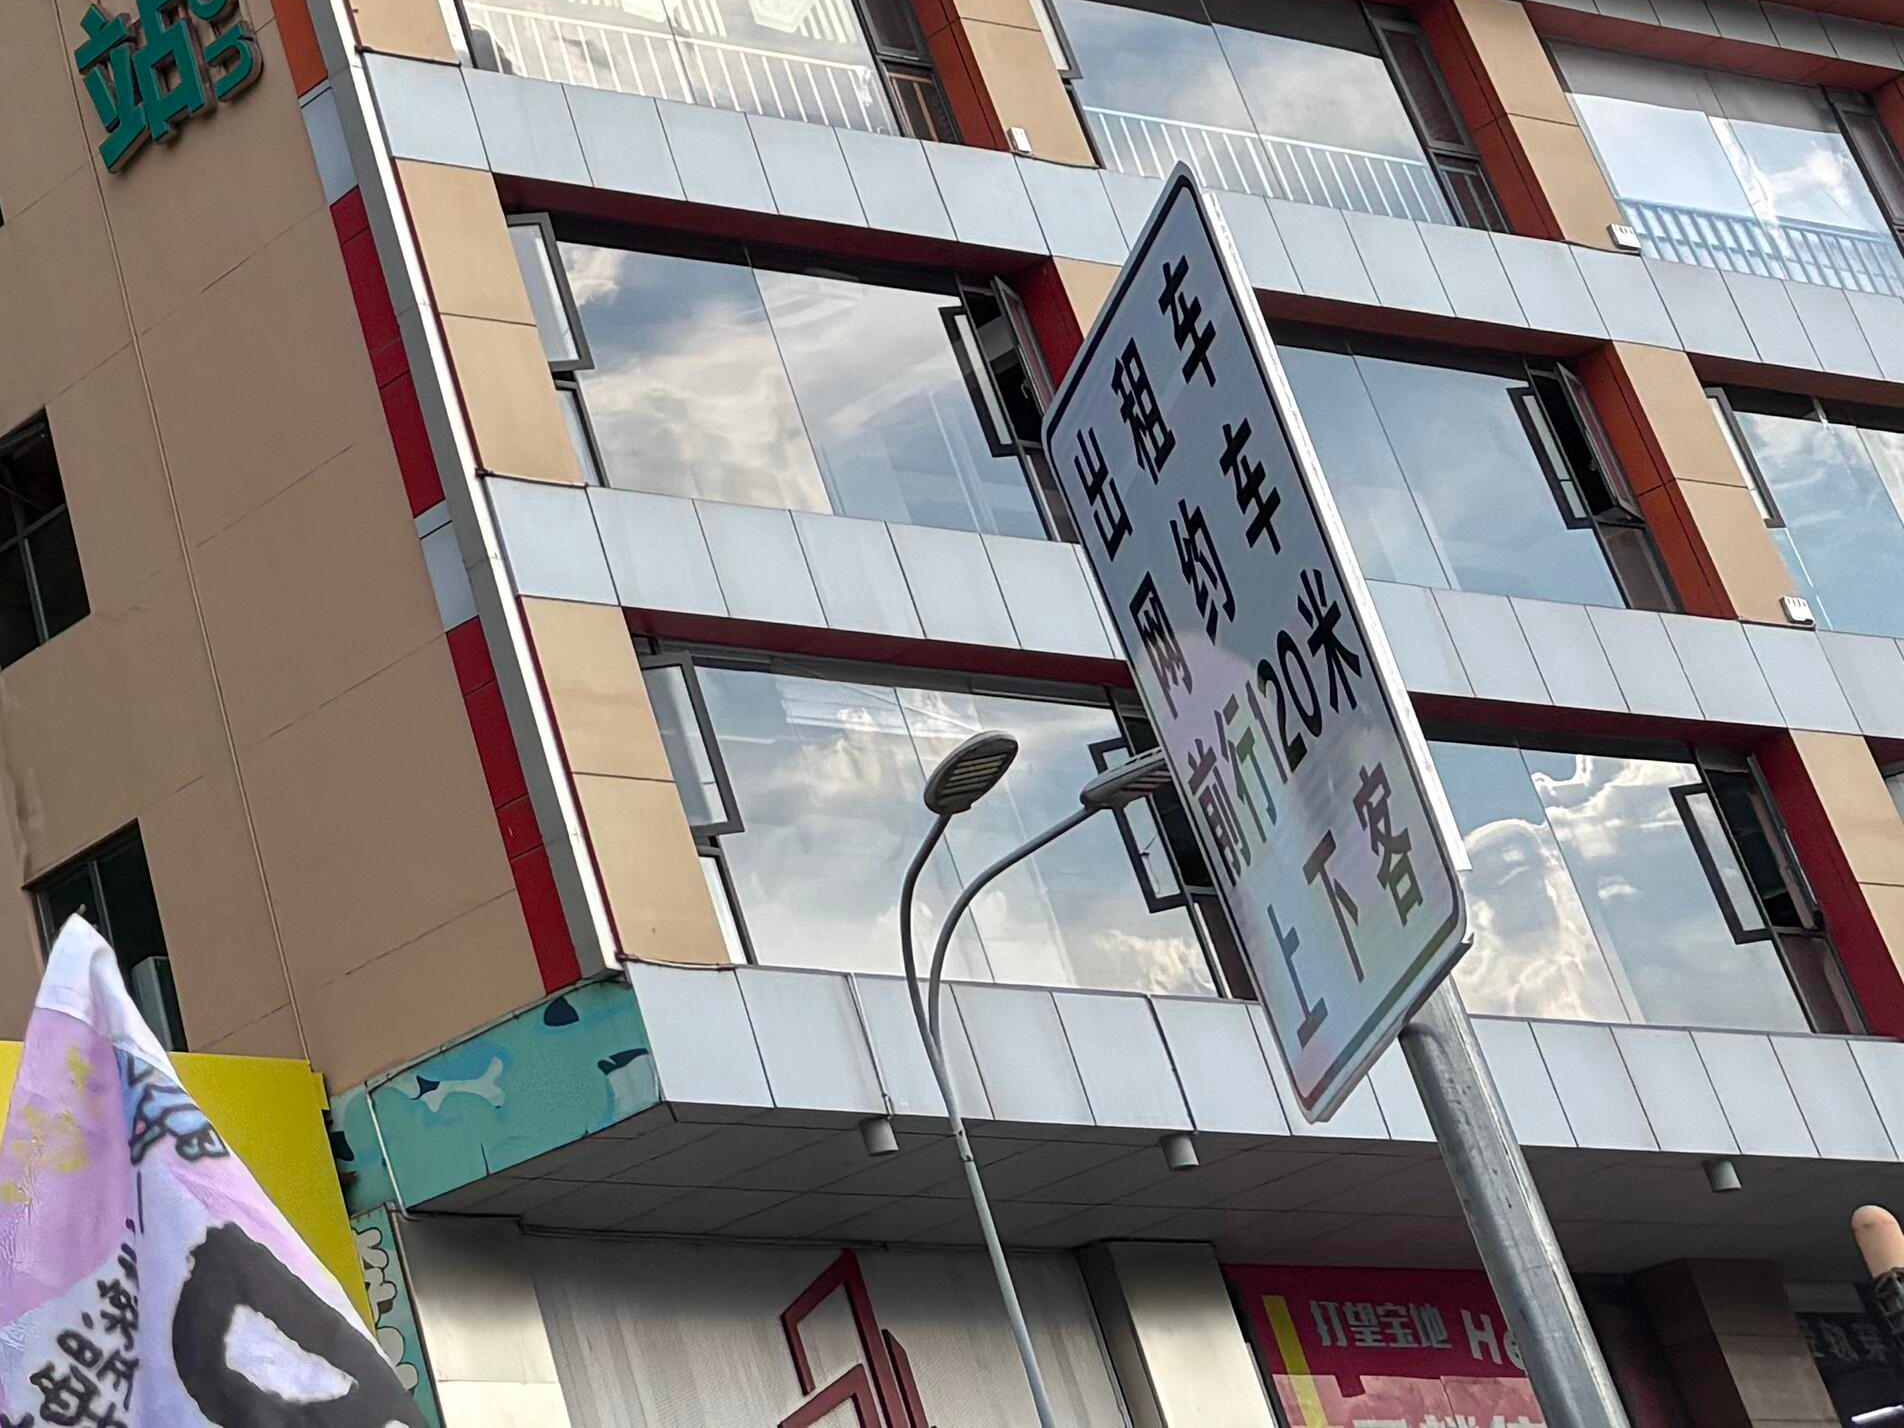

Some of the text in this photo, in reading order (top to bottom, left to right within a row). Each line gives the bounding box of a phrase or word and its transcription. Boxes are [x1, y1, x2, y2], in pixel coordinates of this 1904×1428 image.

[1072, 254, 1217, 561] 出租车
[1130, 418, 1284, 720] 网约车
[1186, 567, 1362, 887] 前行120米
[1263, 761, 1426, 1051] 上下客
[1310, 1300, 1453, 1350] 打望宝地
